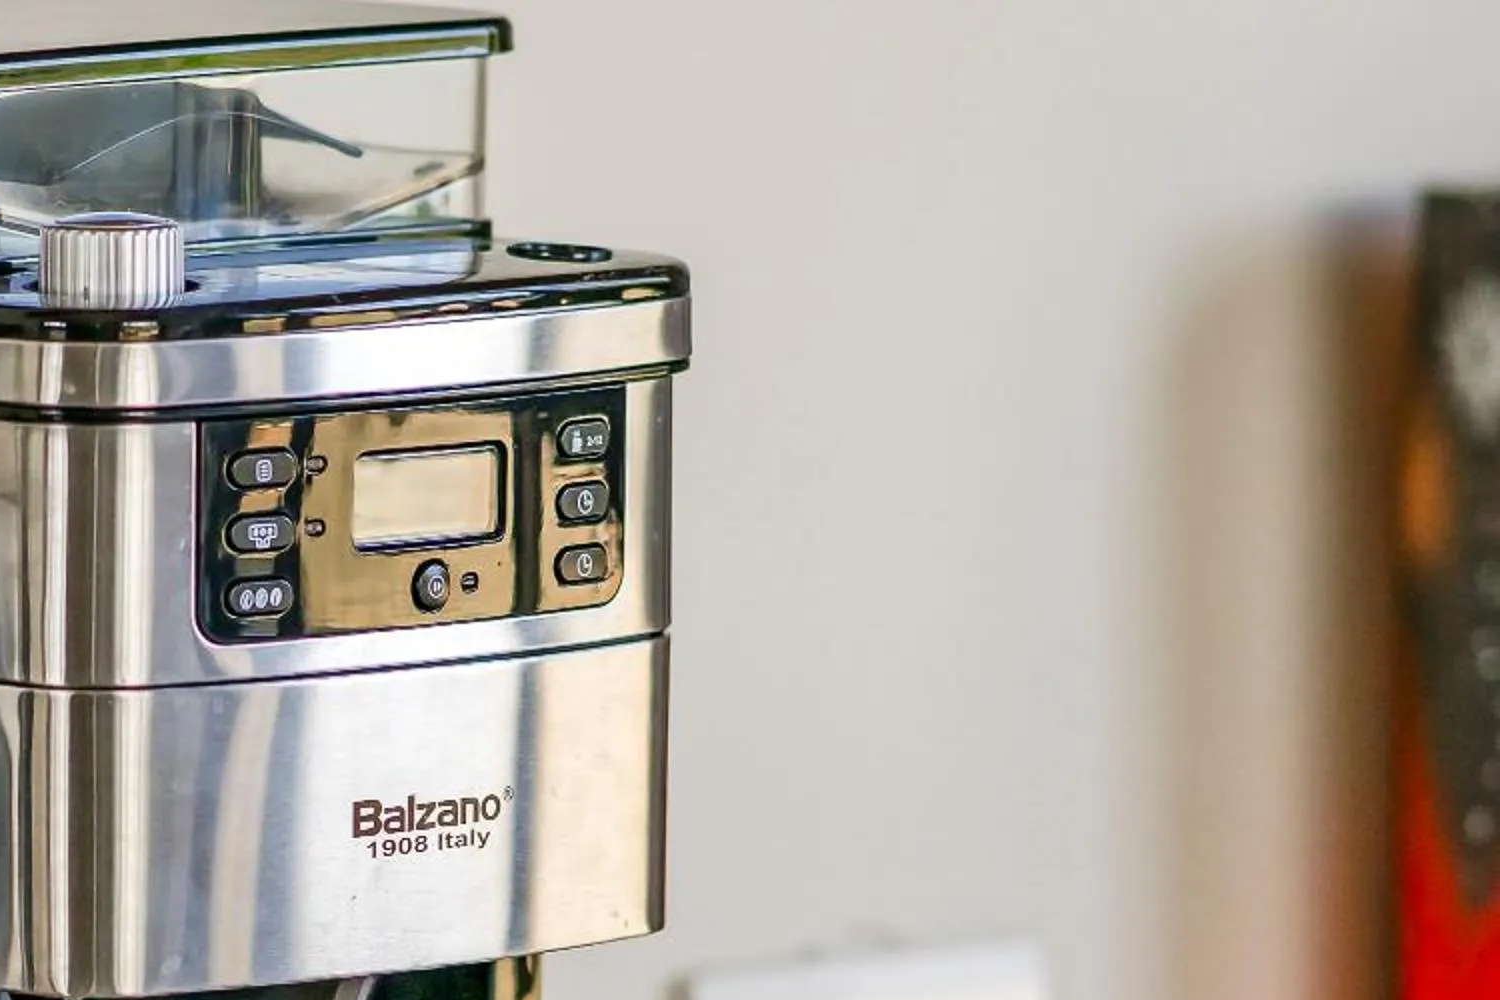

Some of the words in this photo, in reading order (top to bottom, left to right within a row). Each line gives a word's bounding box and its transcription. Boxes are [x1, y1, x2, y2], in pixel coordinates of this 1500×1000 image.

[352, 794, 501, 838] Balzano
[367, 835, 429, 858] 1908
[438, 829, 490, 850] Italy
